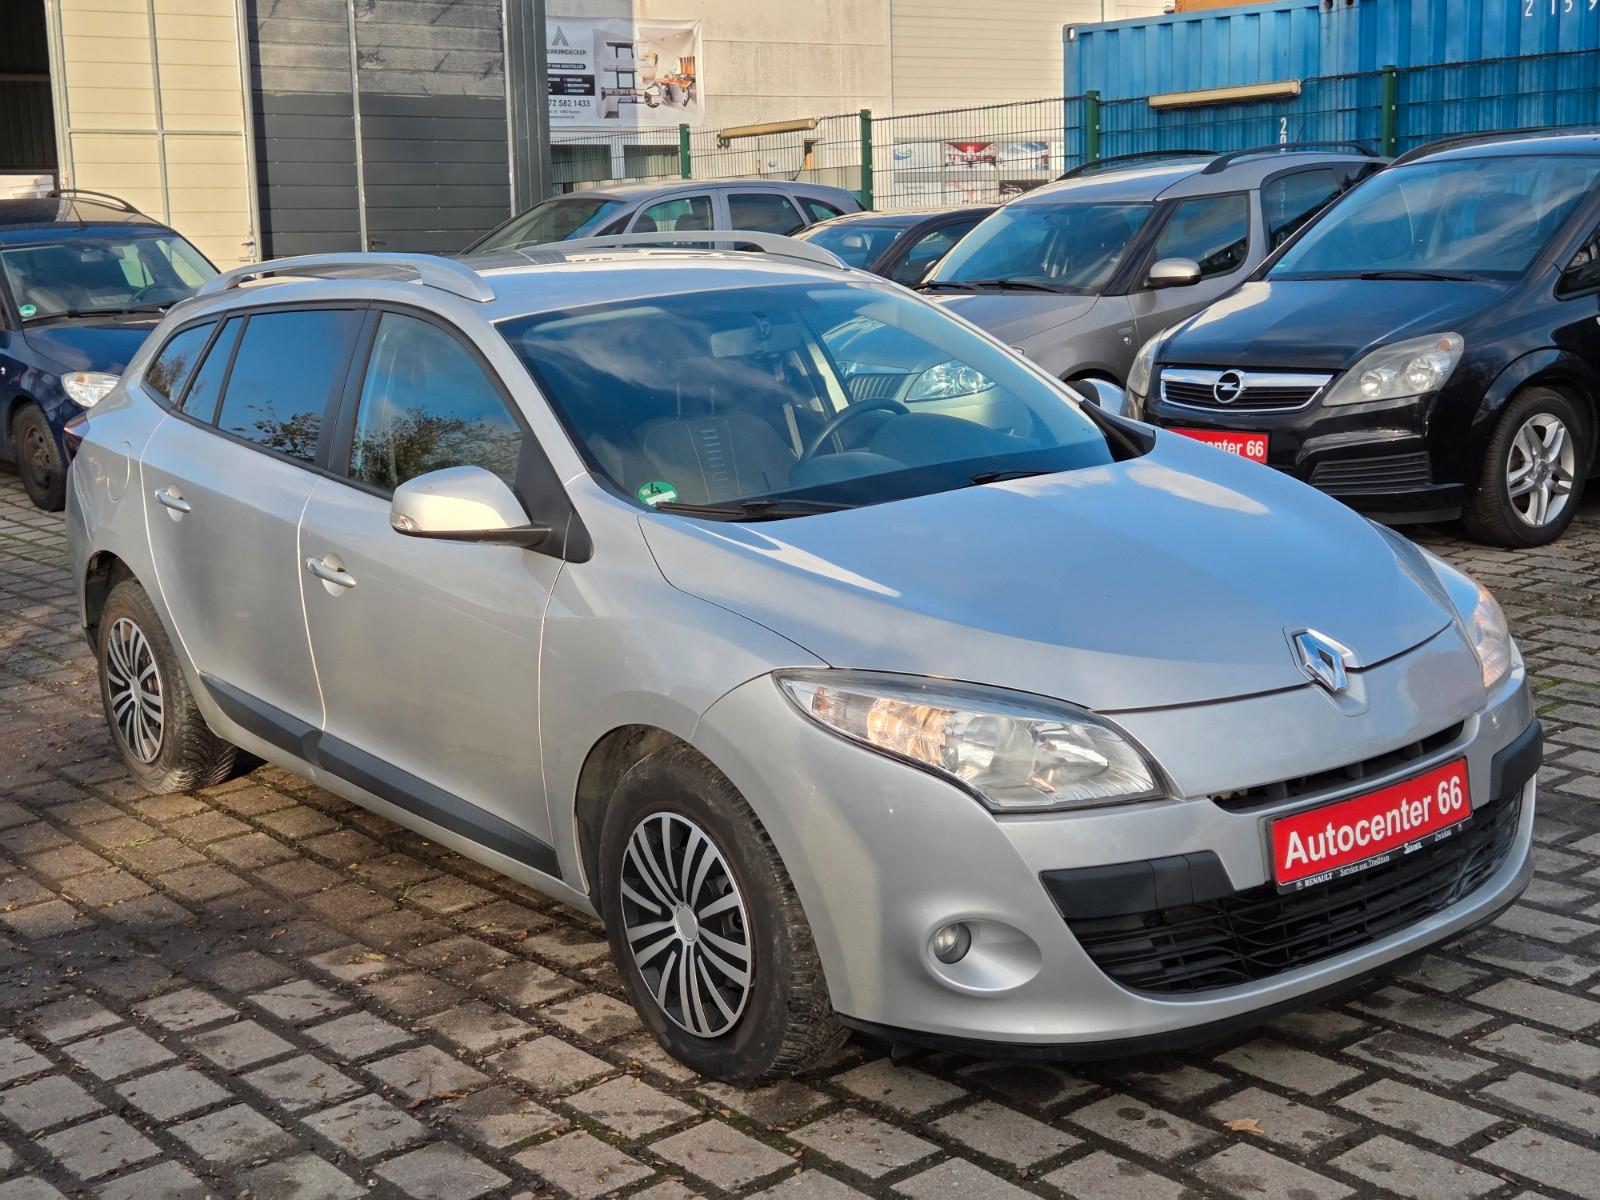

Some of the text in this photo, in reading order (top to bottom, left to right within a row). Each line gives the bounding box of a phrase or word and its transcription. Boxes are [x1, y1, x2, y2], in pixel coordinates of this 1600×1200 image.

[1246, 440, 1264, 457] 66
[650, 482, 663, 494] 4
[1284, 775, 1463, 870] Autocenter 66
[1304, 872, 1334, 887] RENAULT
